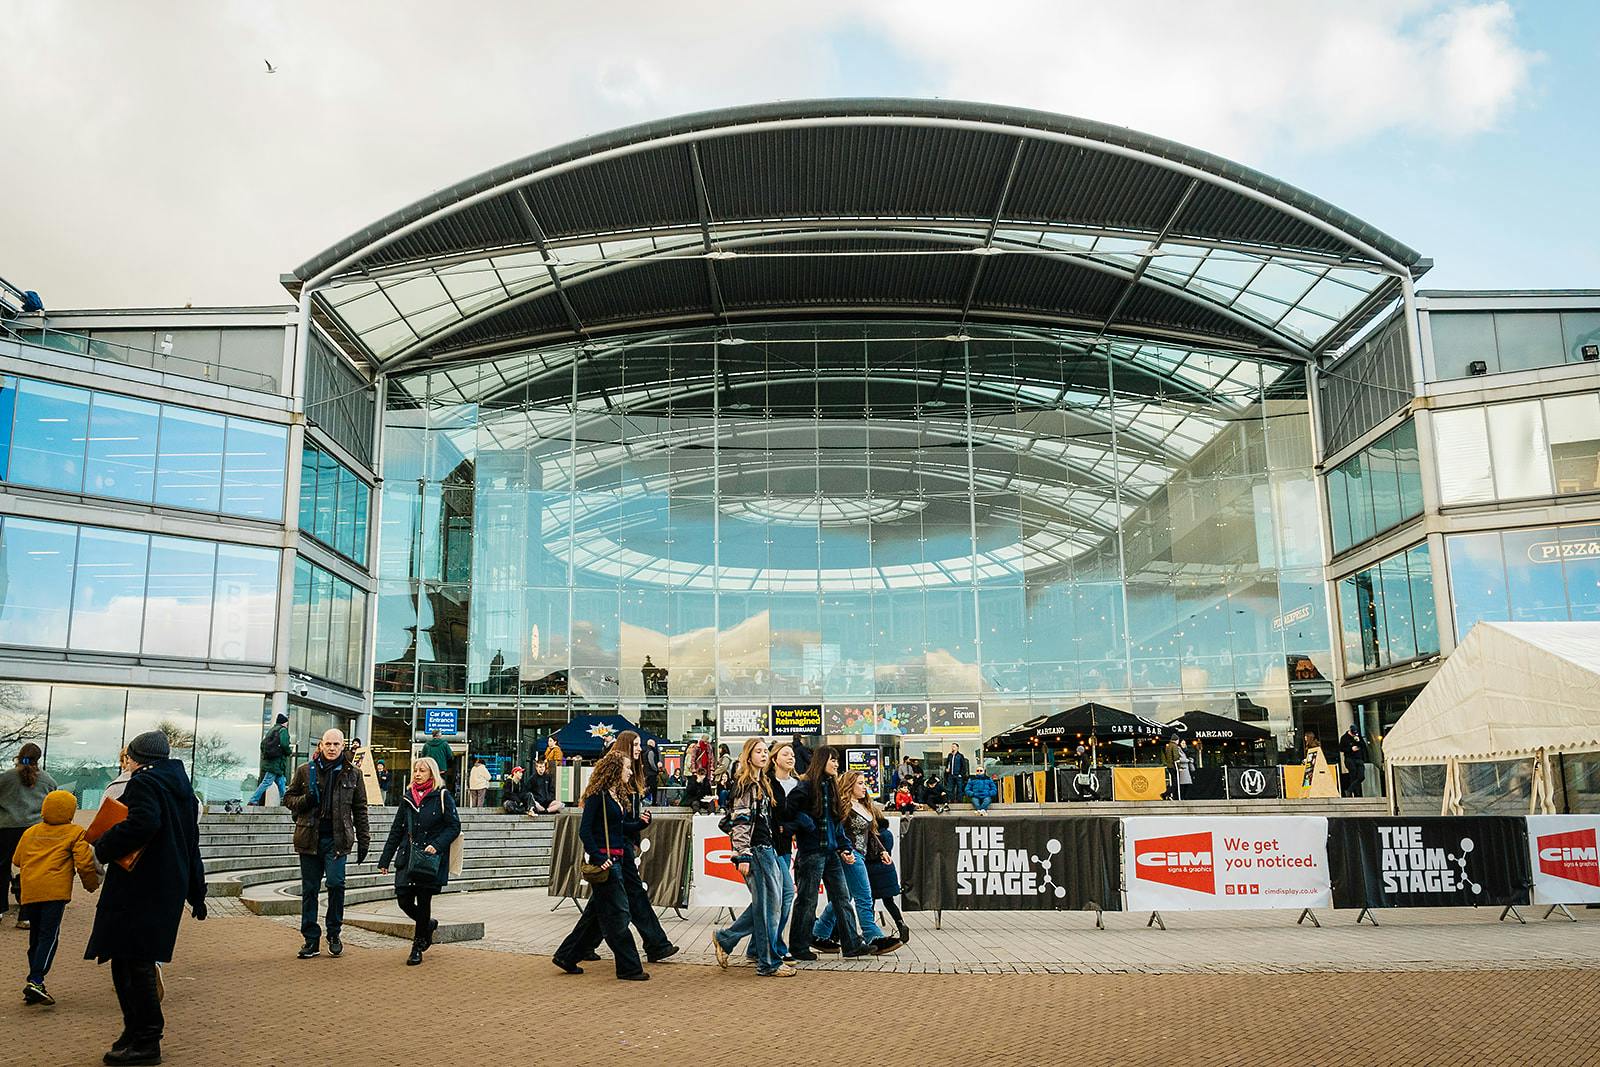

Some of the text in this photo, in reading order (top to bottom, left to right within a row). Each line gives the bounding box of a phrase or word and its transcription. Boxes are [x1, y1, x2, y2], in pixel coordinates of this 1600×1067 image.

[724, 709, 761, 717] NORWICH
[775, 709, 819, 718] Your World,
[724, 717, 757, 725] SCIENCE
[775, 717, 821, 726] Reimagined
[724, 724, 761, 732] FESTIVAL
[1036, 727, 1065, 736] MARZANO
[1111, 725, 1162, 735] CAFE & BAR
[1195, 730, 1233, 738] MARZANO
[955, 826, 1005, 849] THE
[1377, 826, 1424, 849] THE
[1224, 838, 1280, 854] We get
[956, 849, 1030, 872] ATOM
[1225, 854, 1317, 871] you noticed.
[1382, 848, 1448, 870] ATOM
[1188, 866, 1212, 874] graphics
[957, 872, 1038, 895] STAGE
[1382, 870, 1457, 893] STAGE
[1264, 887, 1319, 896] cimdisplay.co.uk
